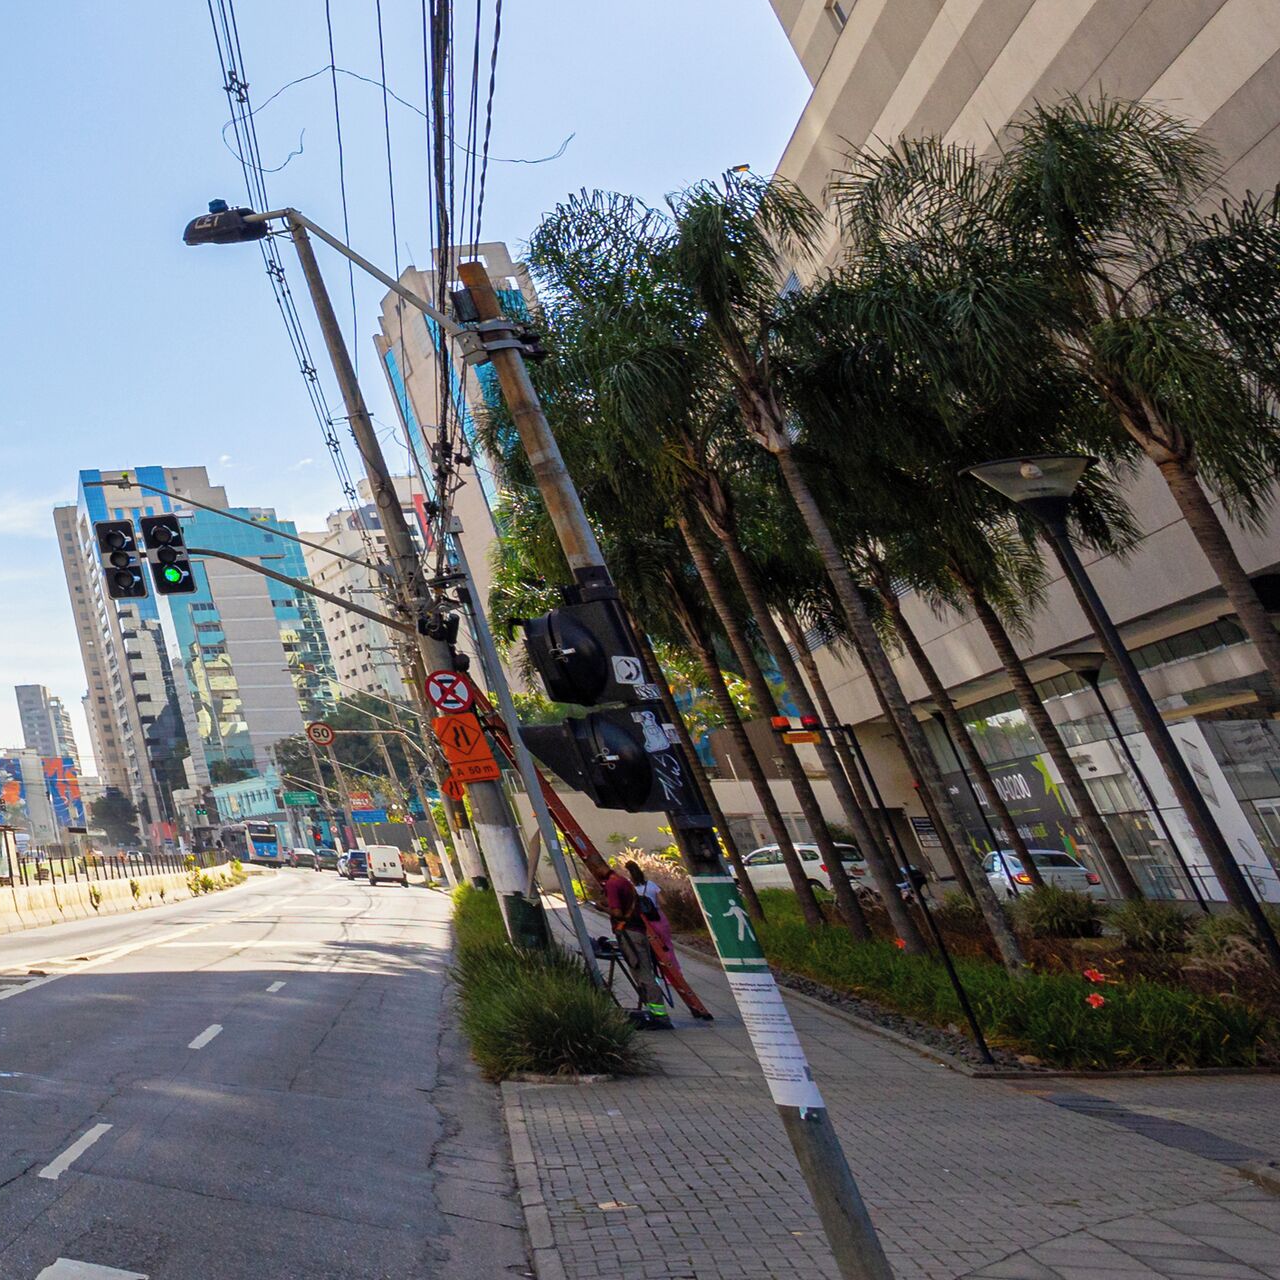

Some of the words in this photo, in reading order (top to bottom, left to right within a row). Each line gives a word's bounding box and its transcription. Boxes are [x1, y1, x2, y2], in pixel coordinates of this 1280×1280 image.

[194, 212, 225, 229] CET
[312, 728, 329, 738] 50
[457, 768, 465, 776] A
[468, 765, 482, 775] 50
[483, 764, 493, 773] m
